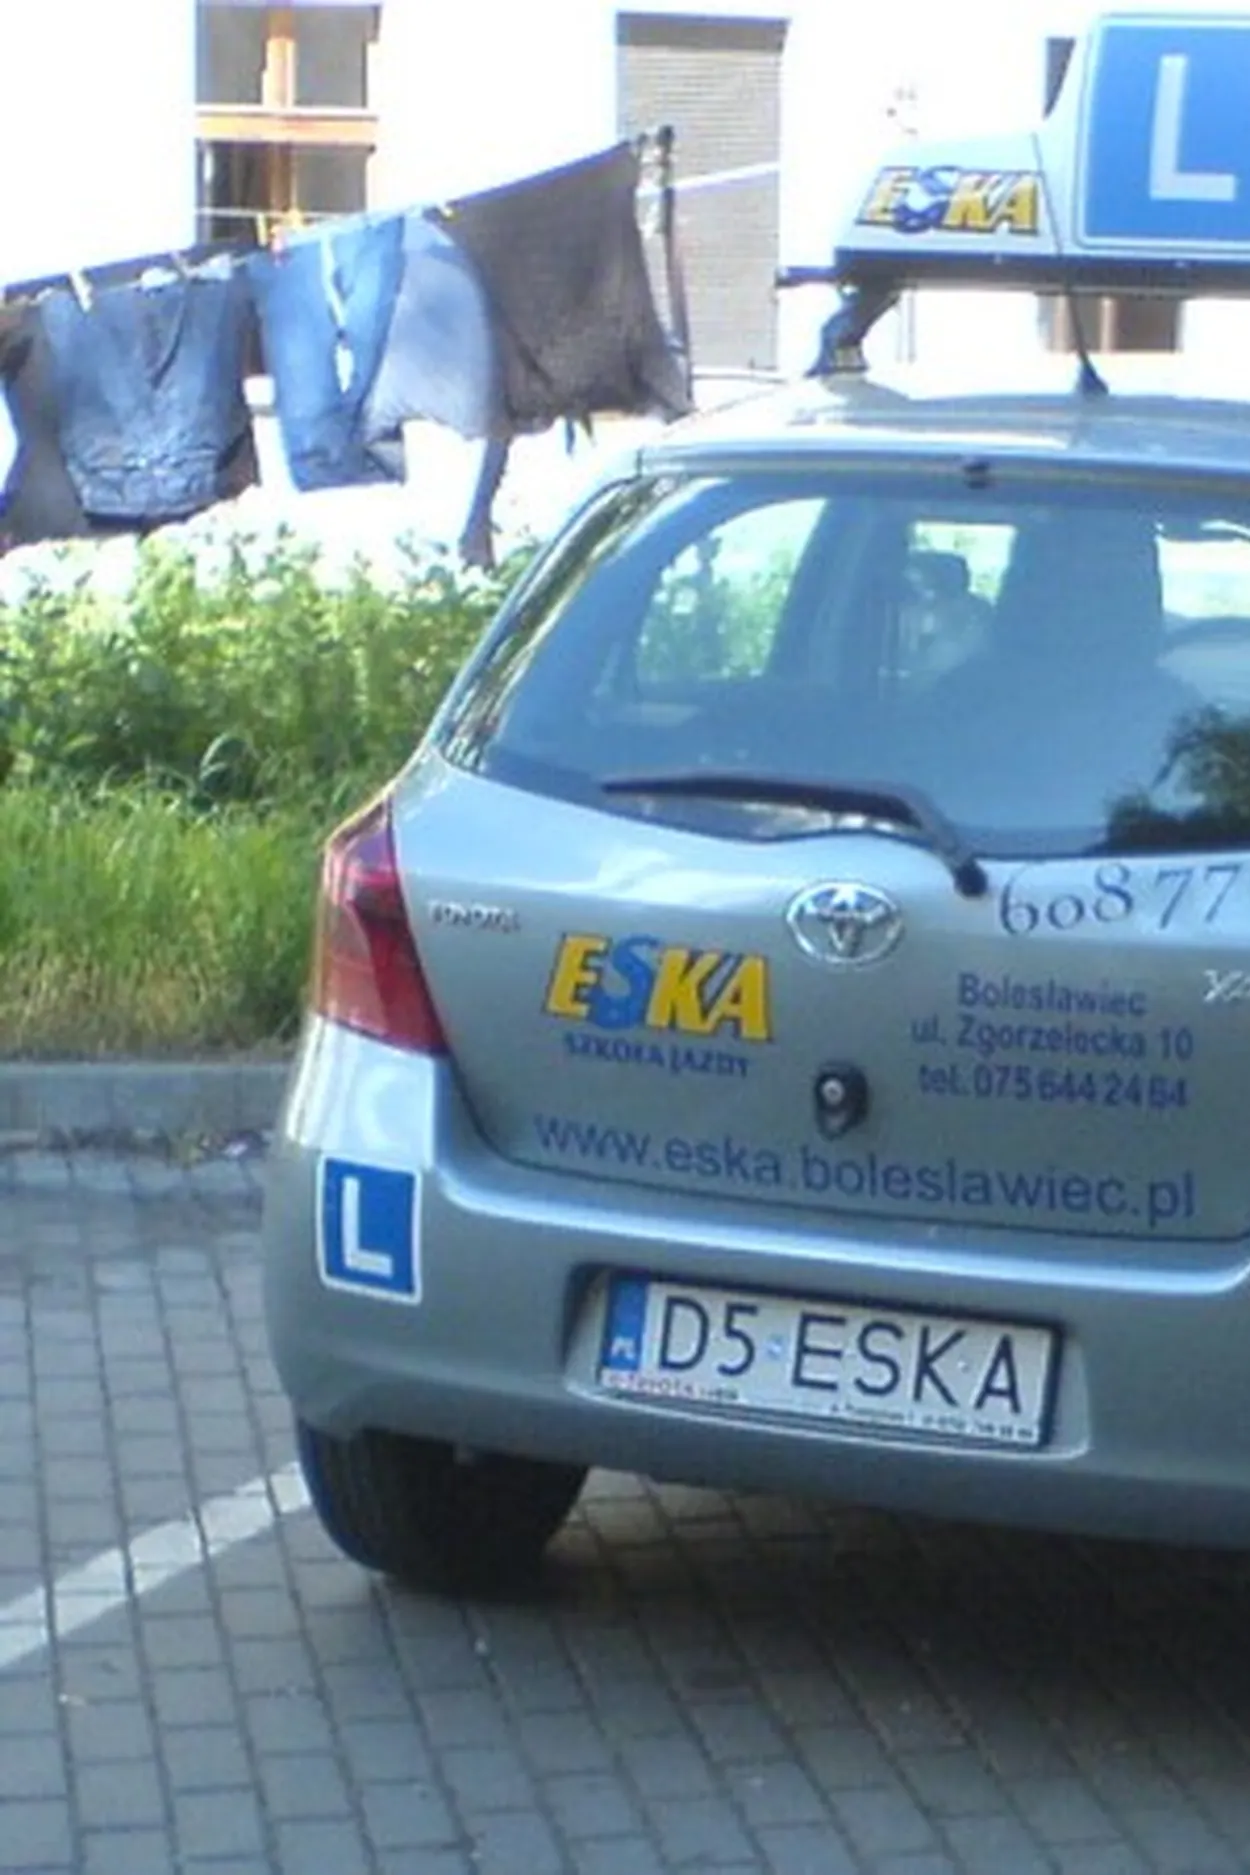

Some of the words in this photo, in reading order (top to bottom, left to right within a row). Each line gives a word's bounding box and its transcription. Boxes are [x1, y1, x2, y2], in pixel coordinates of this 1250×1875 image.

[1149, 54, 1237, 201] L
[854, 165, 1044, 237] ESKA
[999, 859, 1134, 937] 608
[542, 932, 774, 1043] ESKA
[956, 1012, 1147, 1059] Zgorzelecka
[1159, 1026, 1194, 1062] 10
[533, 1113, 1195, 1226] www.eska.boleslawiec.pl
[342, 1175, 393, 1280] L
[658, 1296, 758, 1377] D5
[790, 1310, 1022, 1416] ESKA
